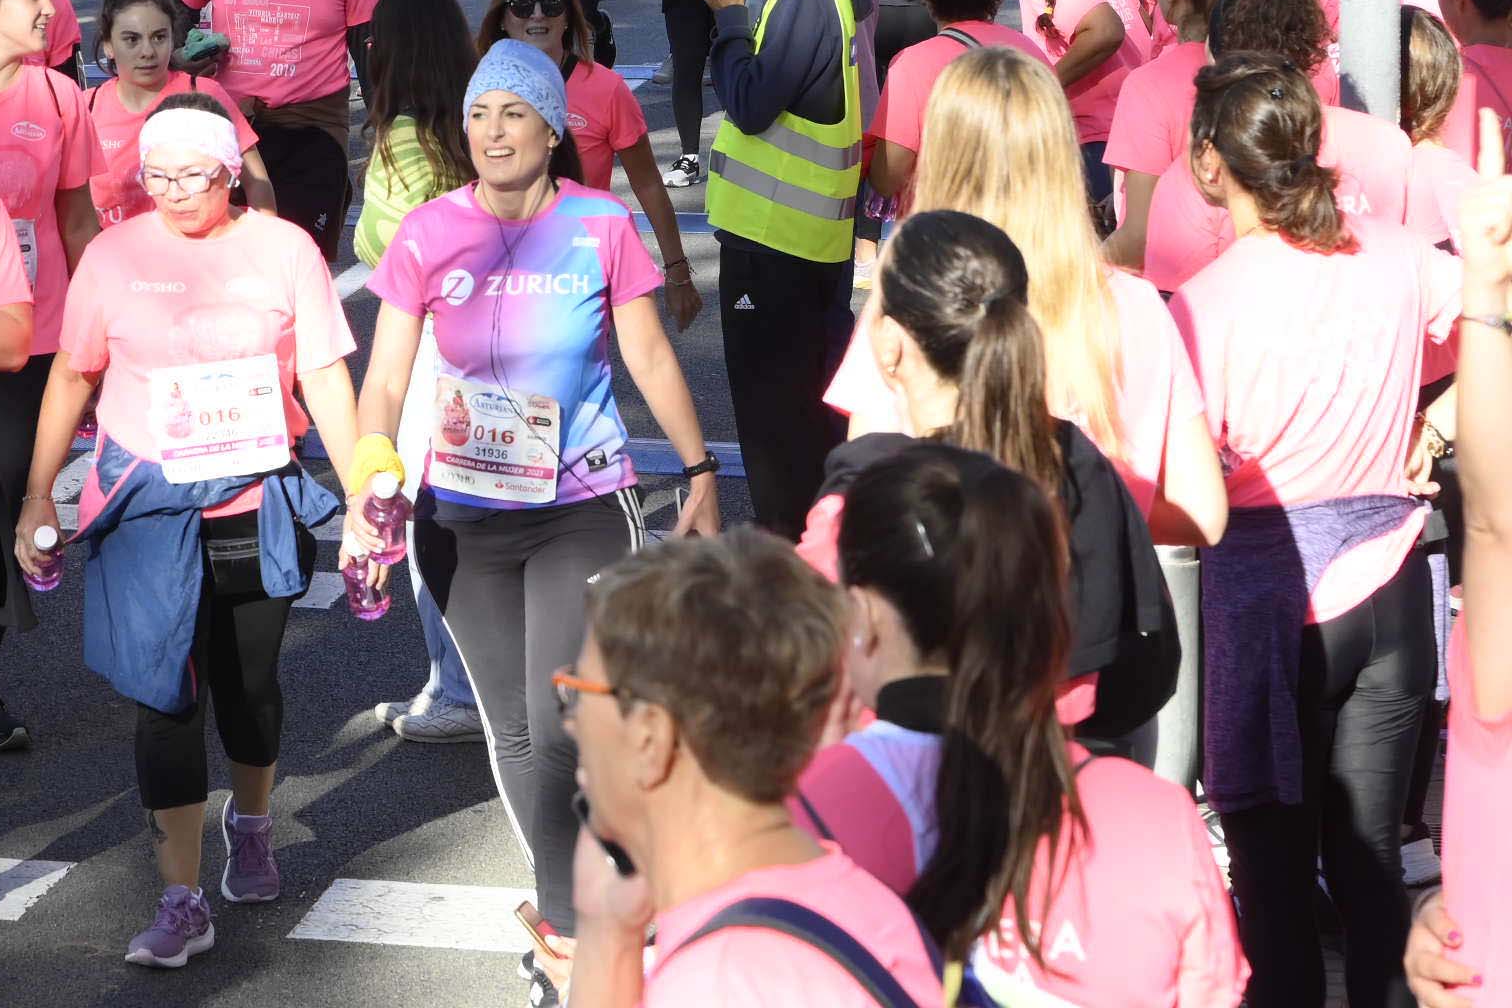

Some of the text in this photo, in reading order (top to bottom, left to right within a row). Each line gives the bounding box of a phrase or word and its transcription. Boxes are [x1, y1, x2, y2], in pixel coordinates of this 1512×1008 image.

[269, 63, 296, 78] 2019
[130, 280, 186, 293] OYSHO
[484, 272, 590, 297] ZURICH
[199, 407, 241, 426] 016
[473, 424, 515, 445] 016
[474, 446, 508, 460] 31936
[445, 456, 476, 468] CARRERA
[477, 461, 486, 470] DE
[488, 463, 498, 472] LA
[505, 481, 546, 493] Santander
